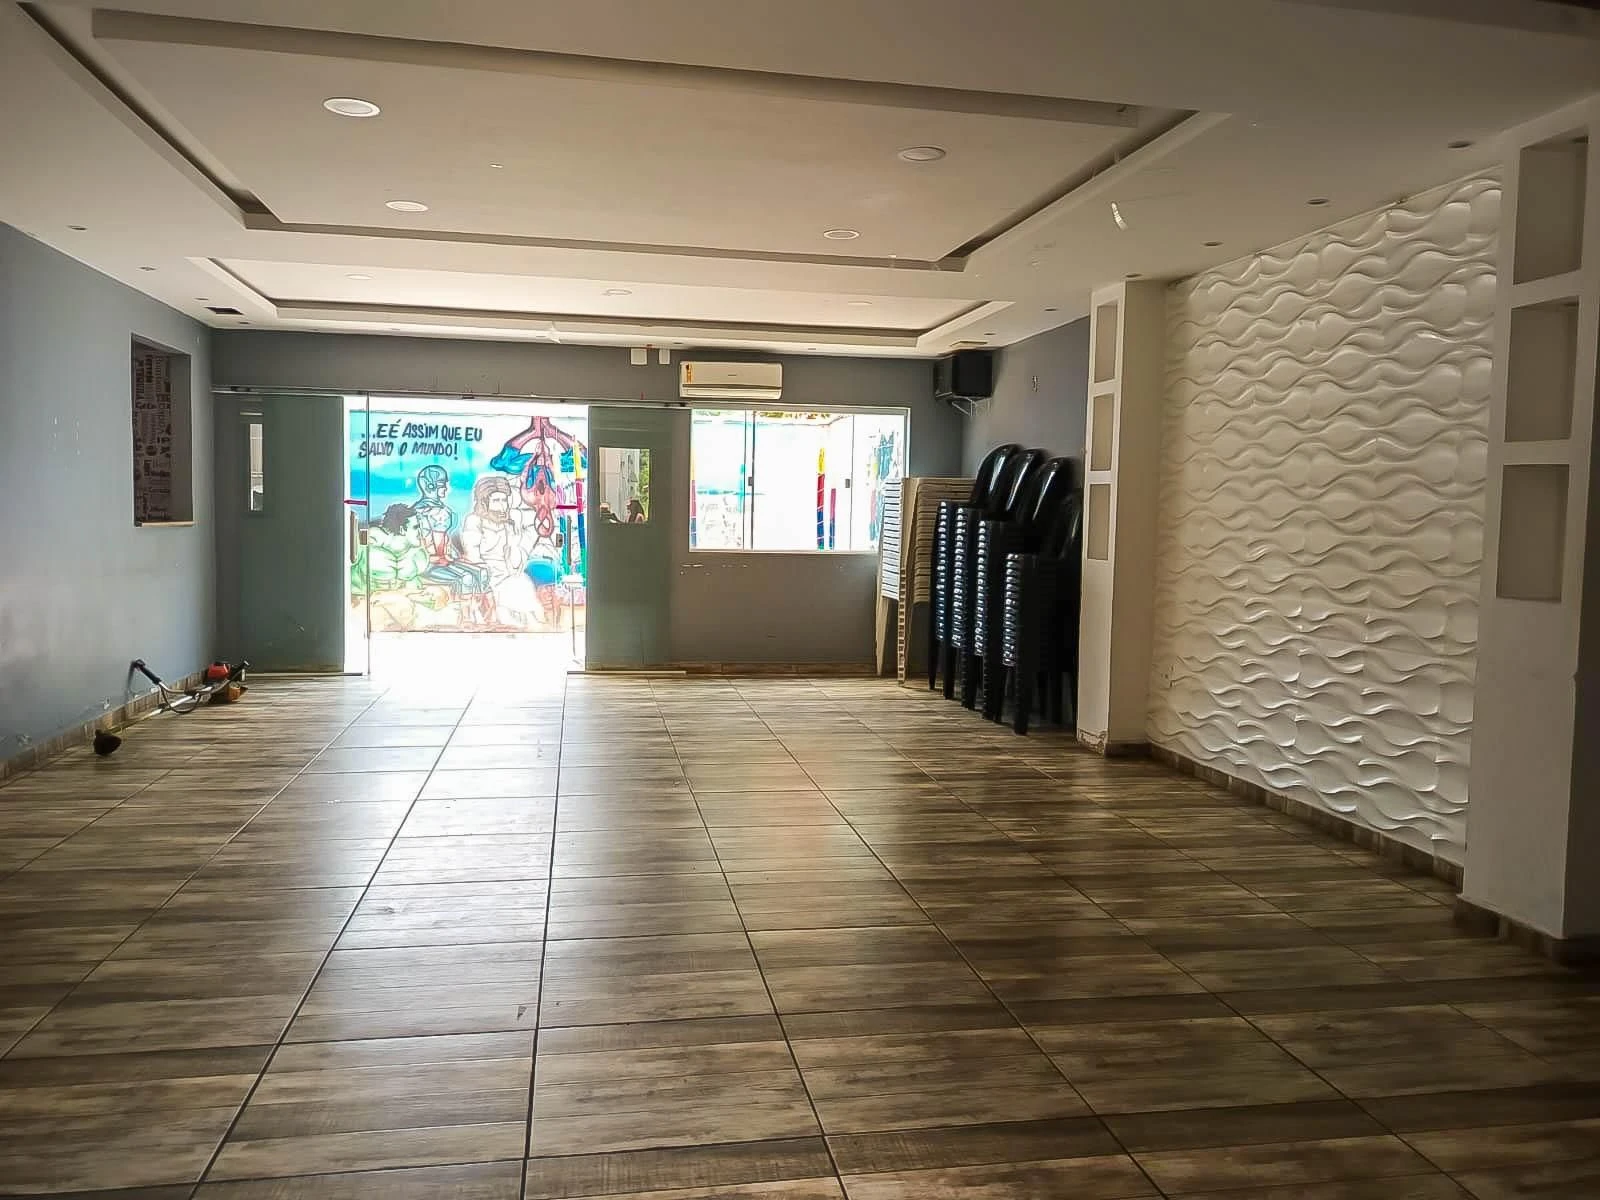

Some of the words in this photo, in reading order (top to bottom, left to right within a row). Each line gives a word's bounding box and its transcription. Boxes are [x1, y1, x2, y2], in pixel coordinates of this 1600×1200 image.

[402, 422, 439, 439] ASSIM
[441, 425, 462, 442] QUE
[465, 427, 483, 442] EU
[358, 440, 394, 458] SALVO
[400, 442, 408, 456] O
[412, 442, 458, 460] MUNDO!
